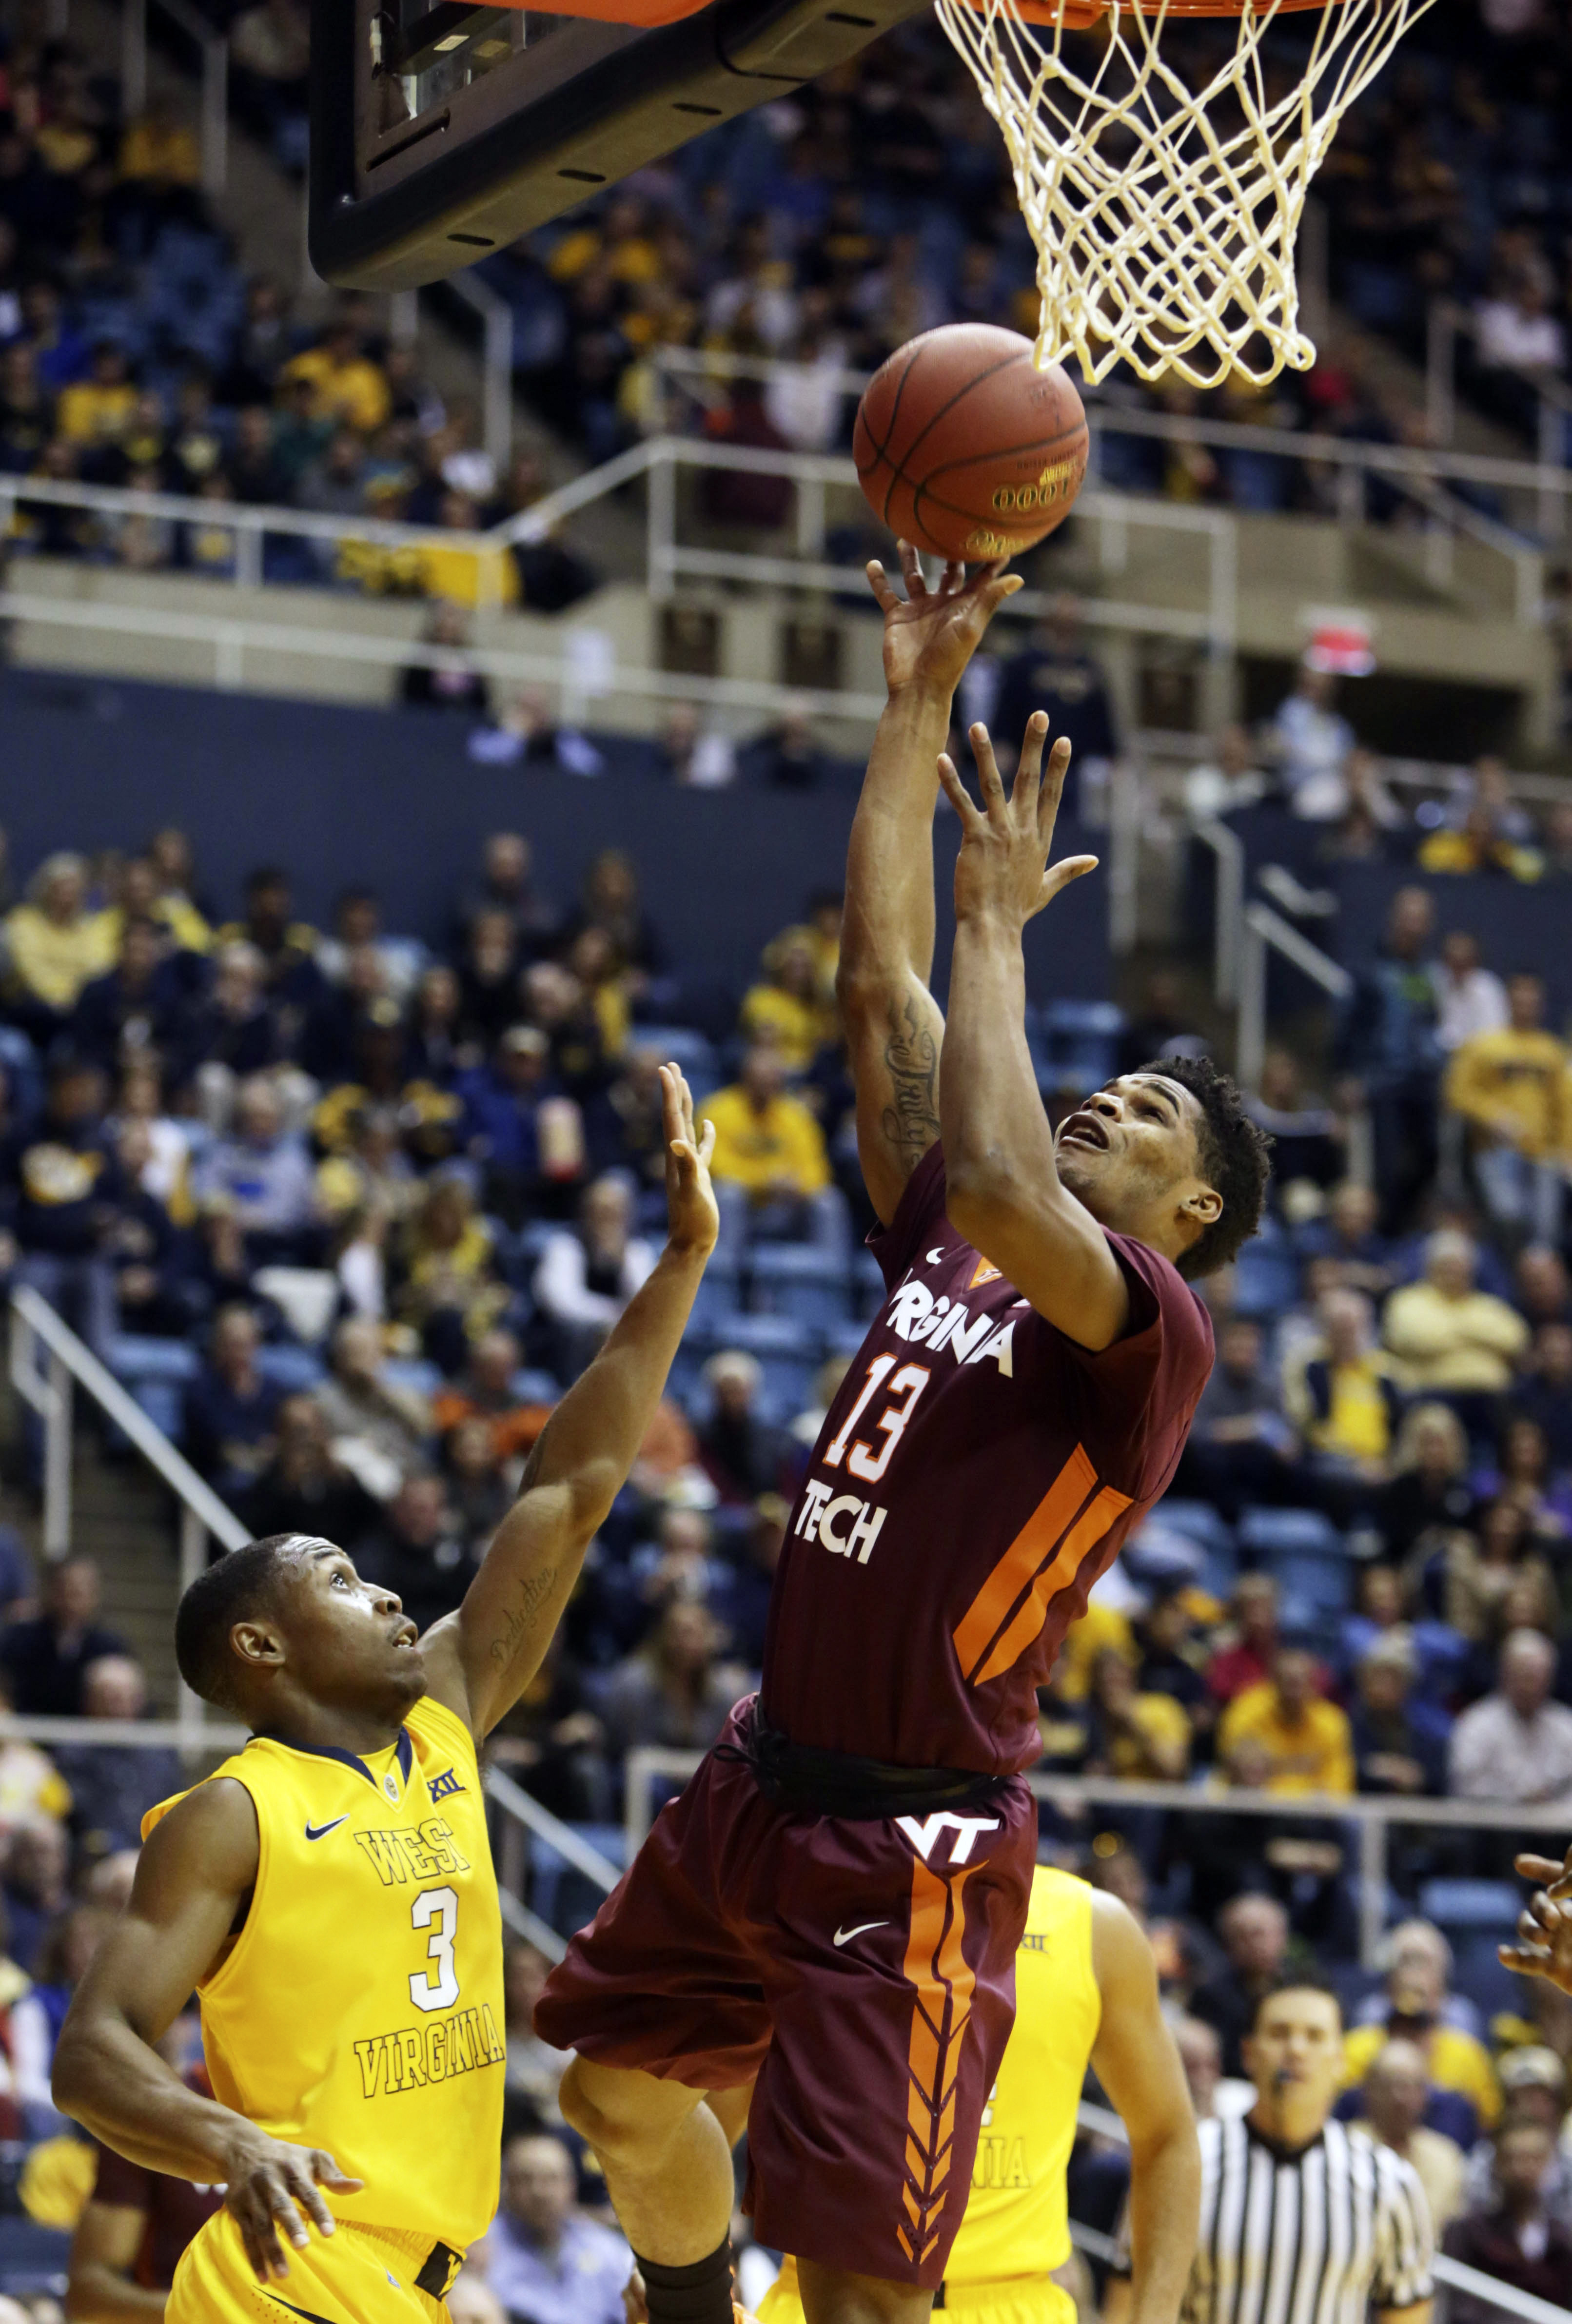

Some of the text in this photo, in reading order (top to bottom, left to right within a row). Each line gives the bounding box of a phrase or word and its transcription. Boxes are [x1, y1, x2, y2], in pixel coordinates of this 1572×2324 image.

[886, 1268, 1017, 1378] RGINA
[822, 1351, 931, 1484] 13
[794, 1478, 888, 1564] TECH
[427, 1767, 467, 1804] XII
[894, 1811, 1001, 1864] VT
[408, 1885, 460, 2012] 3
[354, 2004, 505, 2098] VIRGINIA
